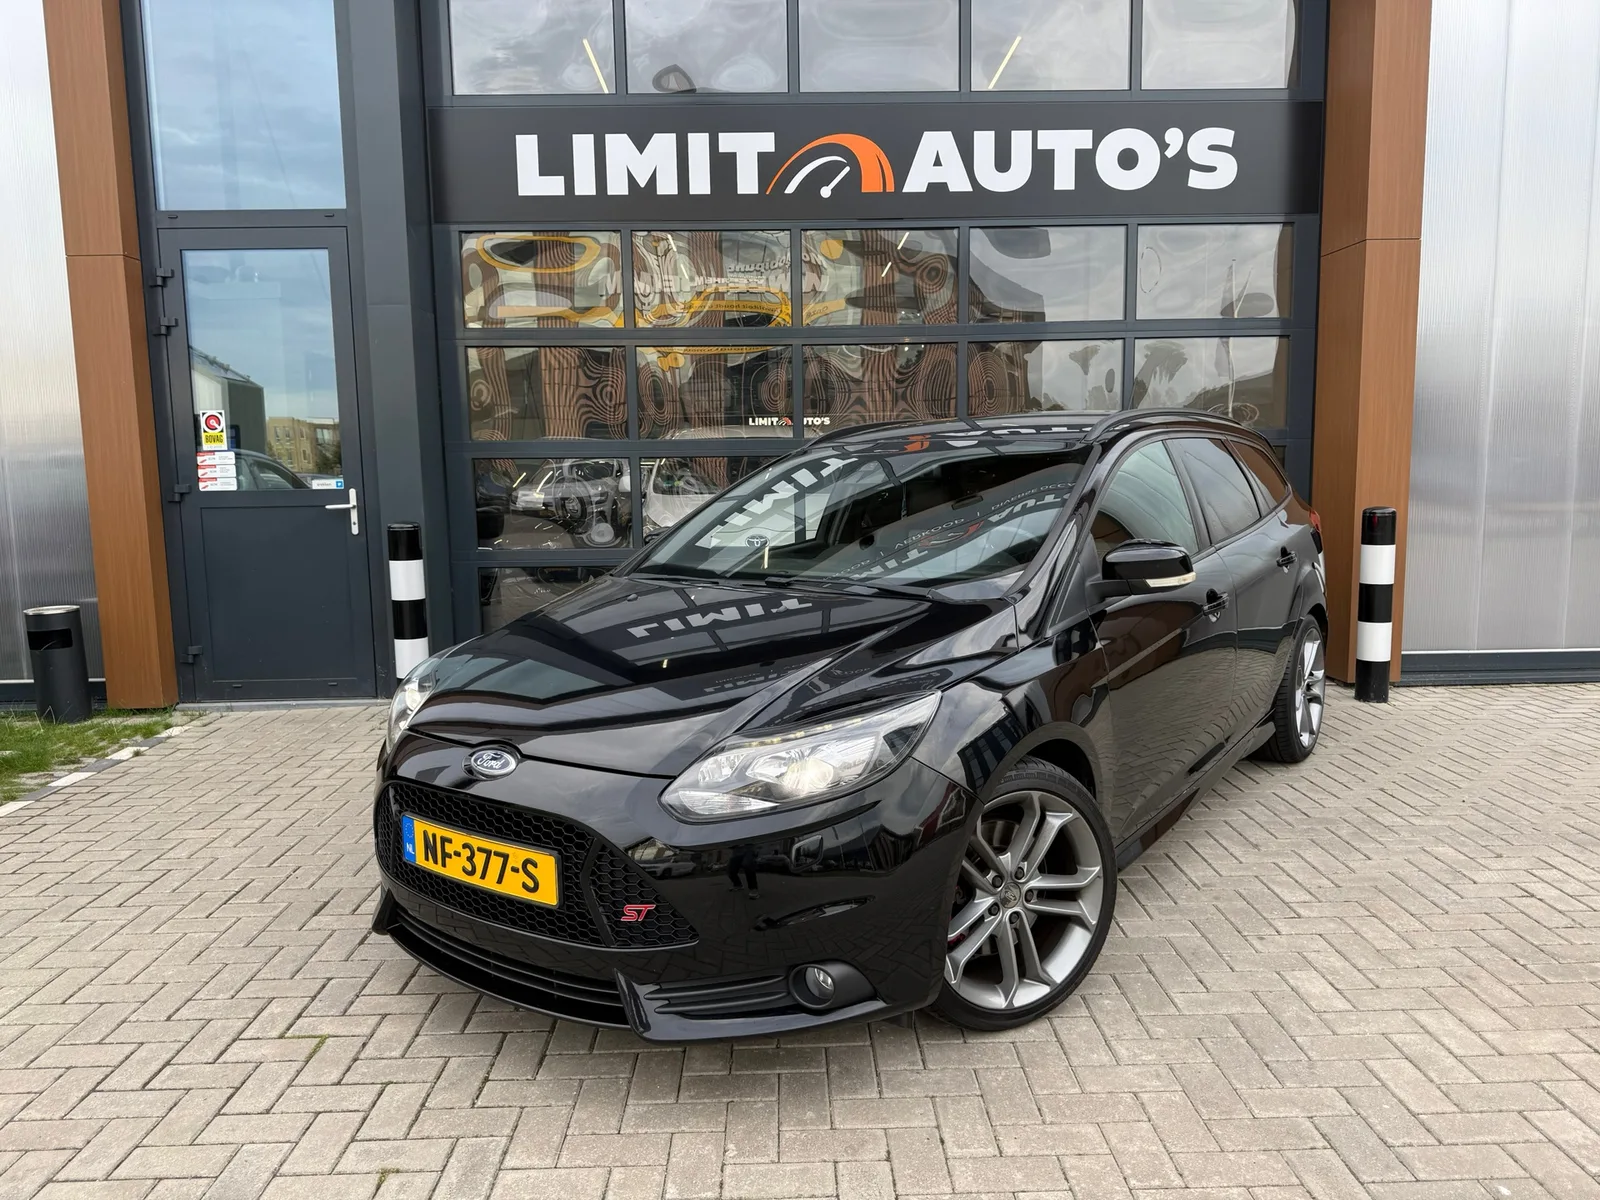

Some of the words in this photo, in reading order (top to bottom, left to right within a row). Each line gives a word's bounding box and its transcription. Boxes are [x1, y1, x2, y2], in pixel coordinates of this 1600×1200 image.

[515, 132, 775, 196] LIMIT
[902, 127, 1239, 193] AUTO'S
[748, 417, 779, 426] LIMIT
[205, 434, 224, 444] BOVAG
[477, 750, 504, 770] Ford
[406, 842, 416, 855] NL
[423, 829, 540, 893] NF-377-S
[621, 904, 656, 922] ST
